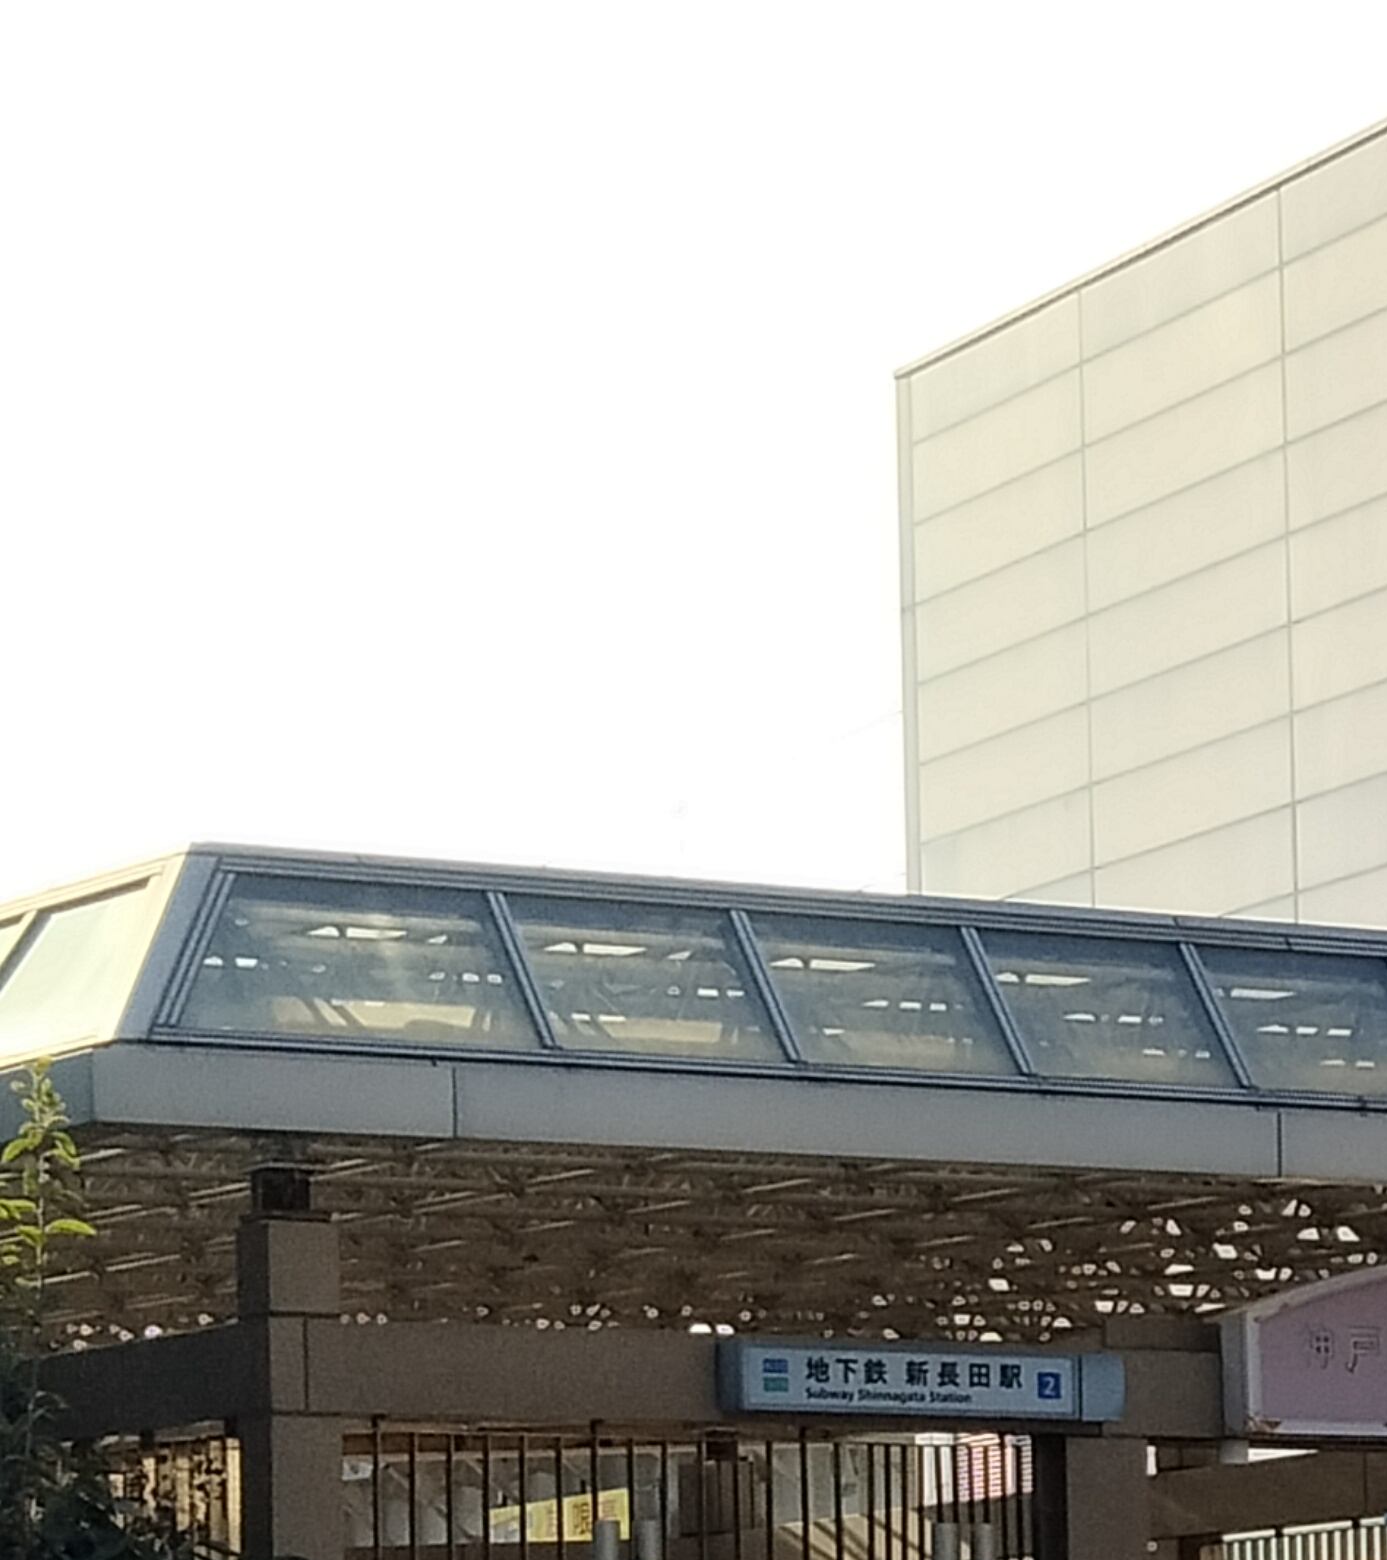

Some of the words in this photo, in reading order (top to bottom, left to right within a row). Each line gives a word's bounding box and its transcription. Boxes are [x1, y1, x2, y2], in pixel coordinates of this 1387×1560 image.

[805, 1356, 888, 1384] 地下鉄
[904, 1360, 1023, 1389] 新長田駅
[805, 1387, 855, 1402] Subway
[930, 1391, 972, 1403] Station
[1043, 1379, 1056, 1396] 2
